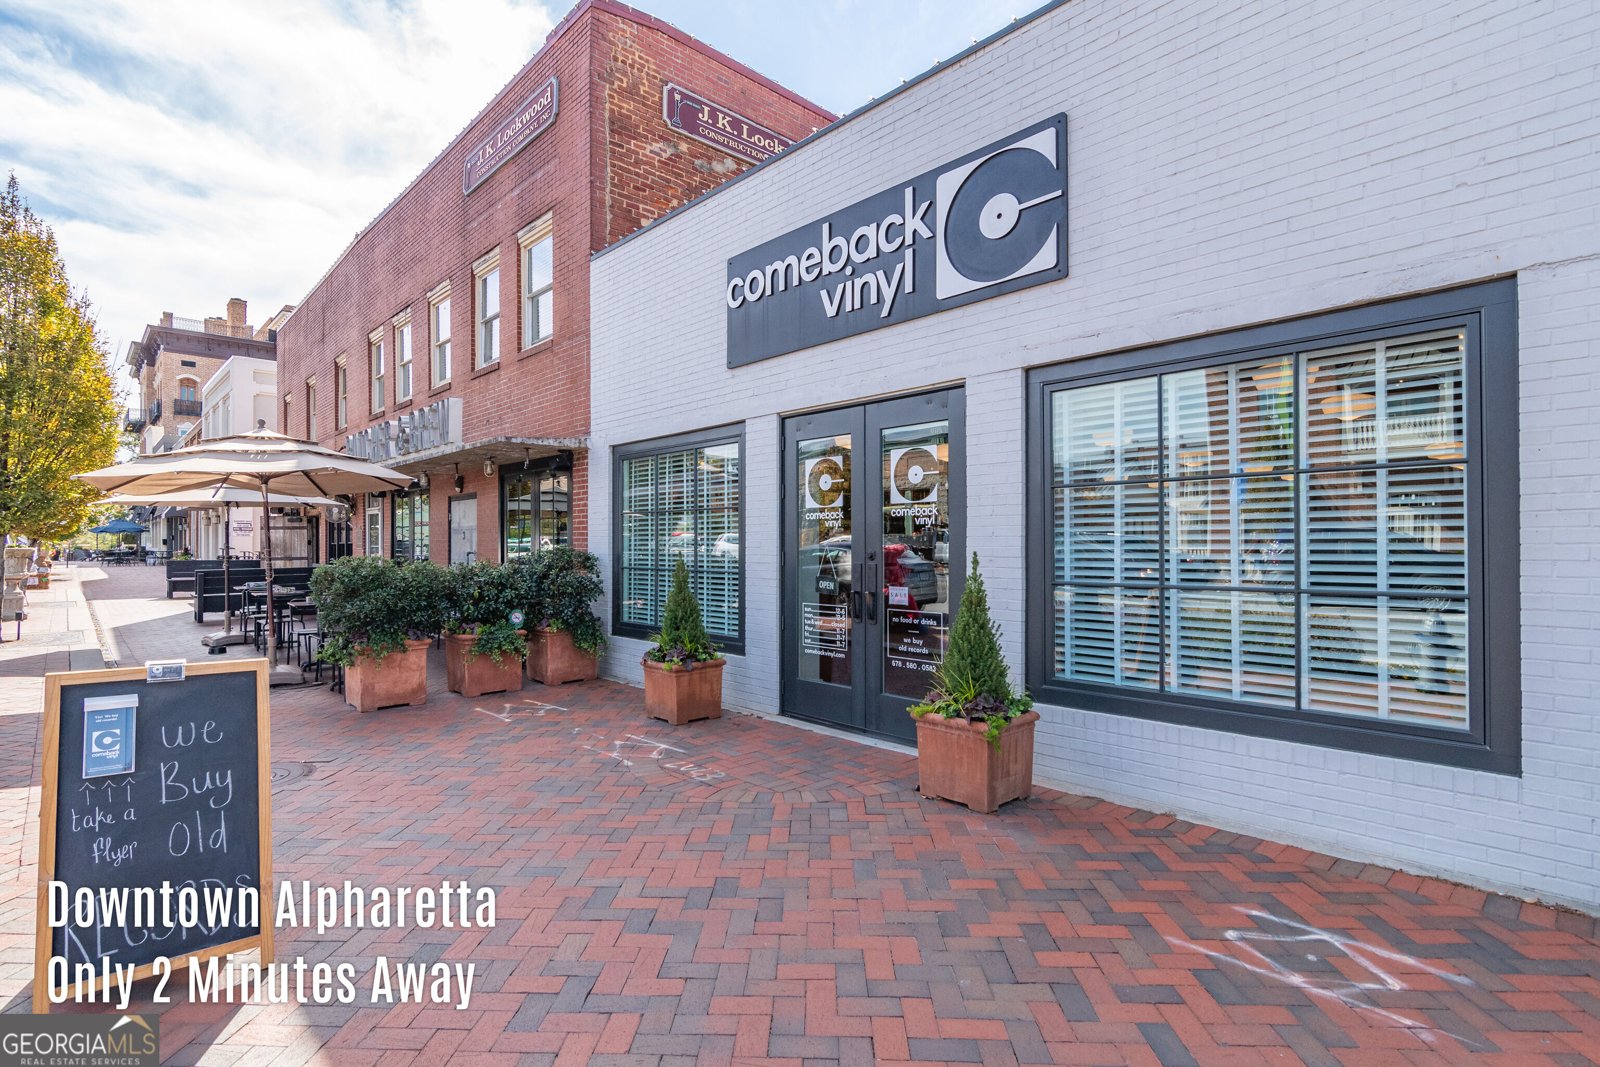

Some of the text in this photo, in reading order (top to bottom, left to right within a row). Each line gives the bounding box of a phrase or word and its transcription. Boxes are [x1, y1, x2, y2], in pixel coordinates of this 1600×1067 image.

[497, 86, 552, 149] Lockwood
[698, 104, 713, 124] J.
[716, 111, 738, 135] K.
[699, 126, 769, 160] CONSTRUCTION
[476, 144, 512, 178] CONSTRUCTION
[727, 186, 934, 309] comeback
[819, 247, 915, 318] vinyl
[805, 507, 844, 520] comeback
[824, 517, 842, 529] vinyl
[890, 503, 938, 517] comeback
[914, 515, 935, 528] vinyl
[818, 580, 834, 590] OPEN
[900, 616, 912, 624] food
[920, 617, 937, 626] drinks
[907, 647, 929, 655] records
[912, 637, 924, 646] buy
[159, 761, 232, 809] Buy
[71, 806, 137, 833] take a
[91, 836, 138, 867] flyer
